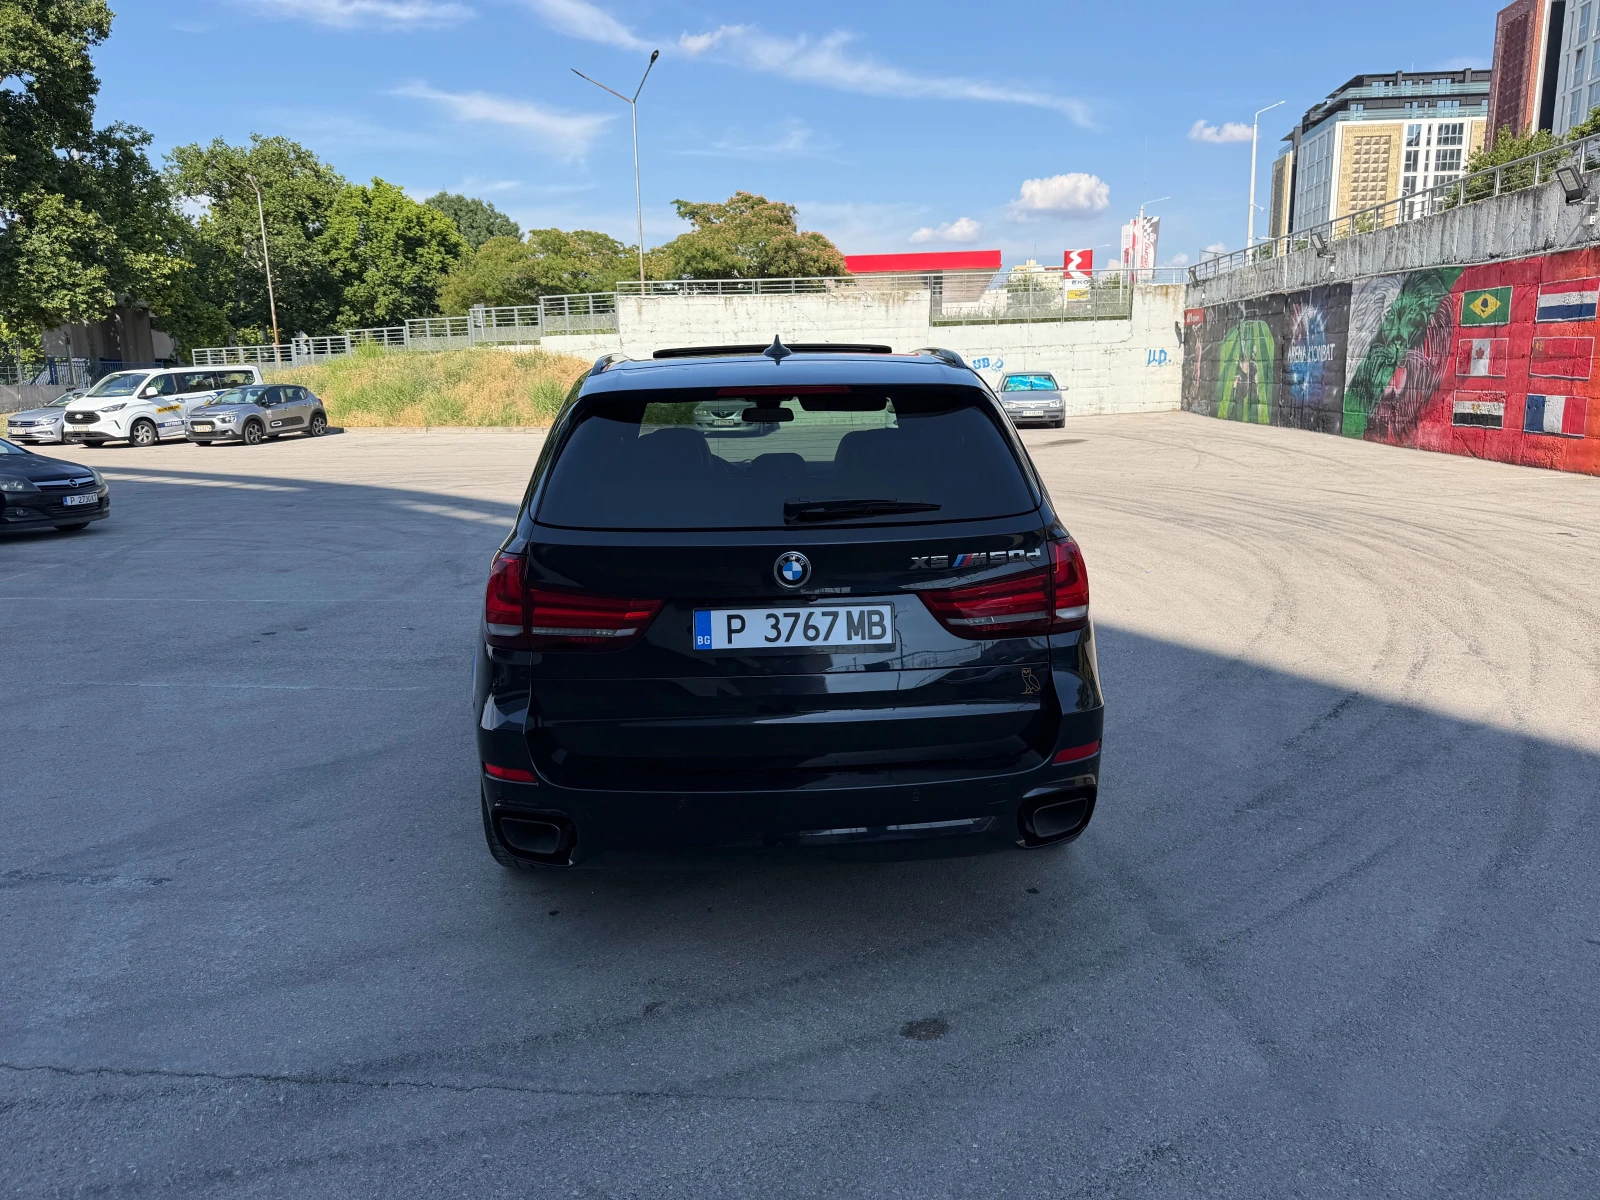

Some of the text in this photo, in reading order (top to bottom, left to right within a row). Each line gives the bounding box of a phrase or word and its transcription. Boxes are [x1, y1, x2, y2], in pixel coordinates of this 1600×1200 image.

[779, 555, 806, 567] BMW
[909, 555, 948, 569] X5
[727, 610, 887, 644] P 3767 MB
[697, 636, 711, 645] BG
